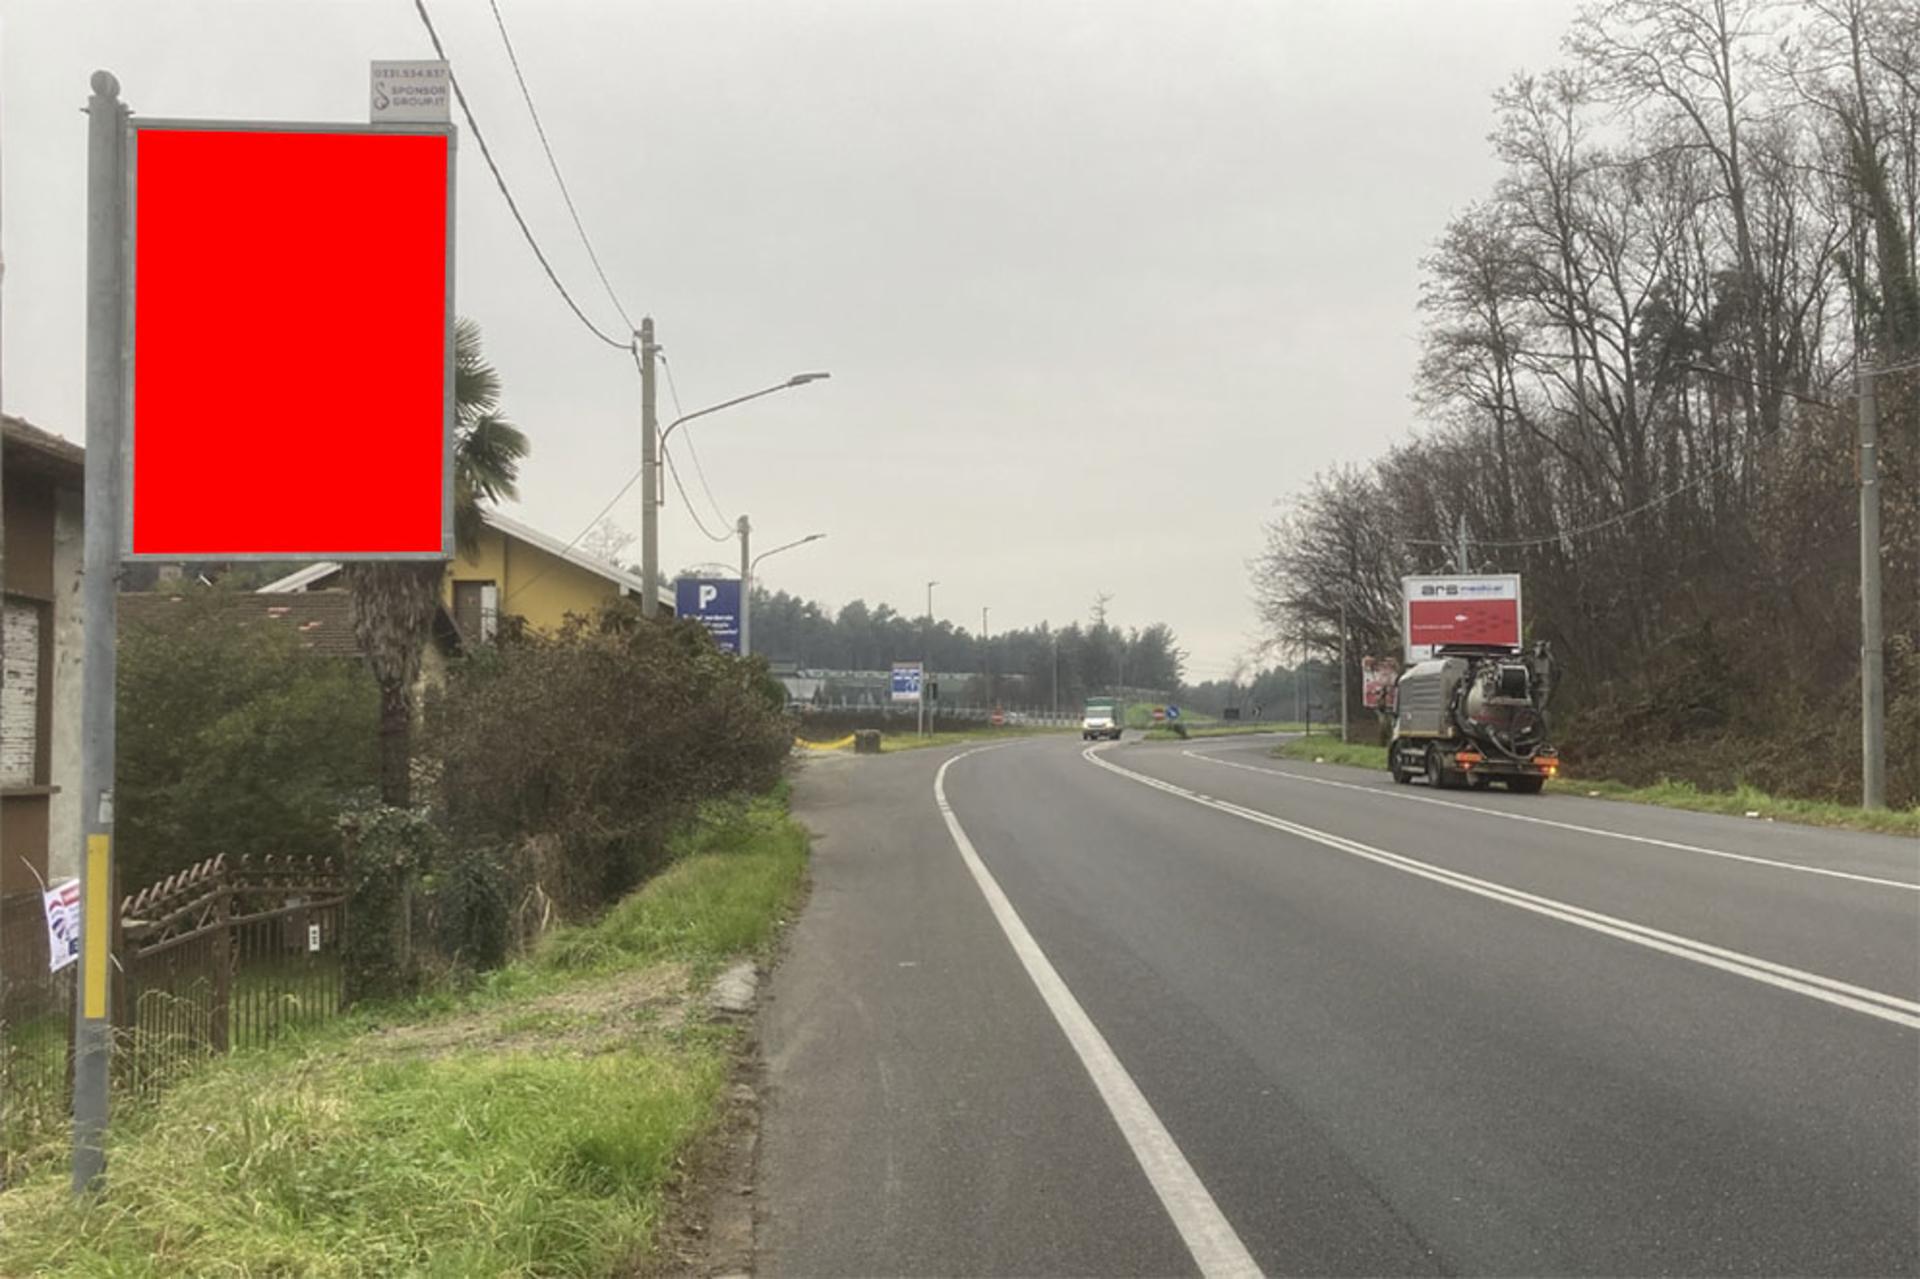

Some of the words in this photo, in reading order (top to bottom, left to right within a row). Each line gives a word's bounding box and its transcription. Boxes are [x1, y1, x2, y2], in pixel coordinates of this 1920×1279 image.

[391, 86, 446, 95] SPONSOR
[1421, 585, 1458, 596] ars
[699, 585, 717, 609] P
